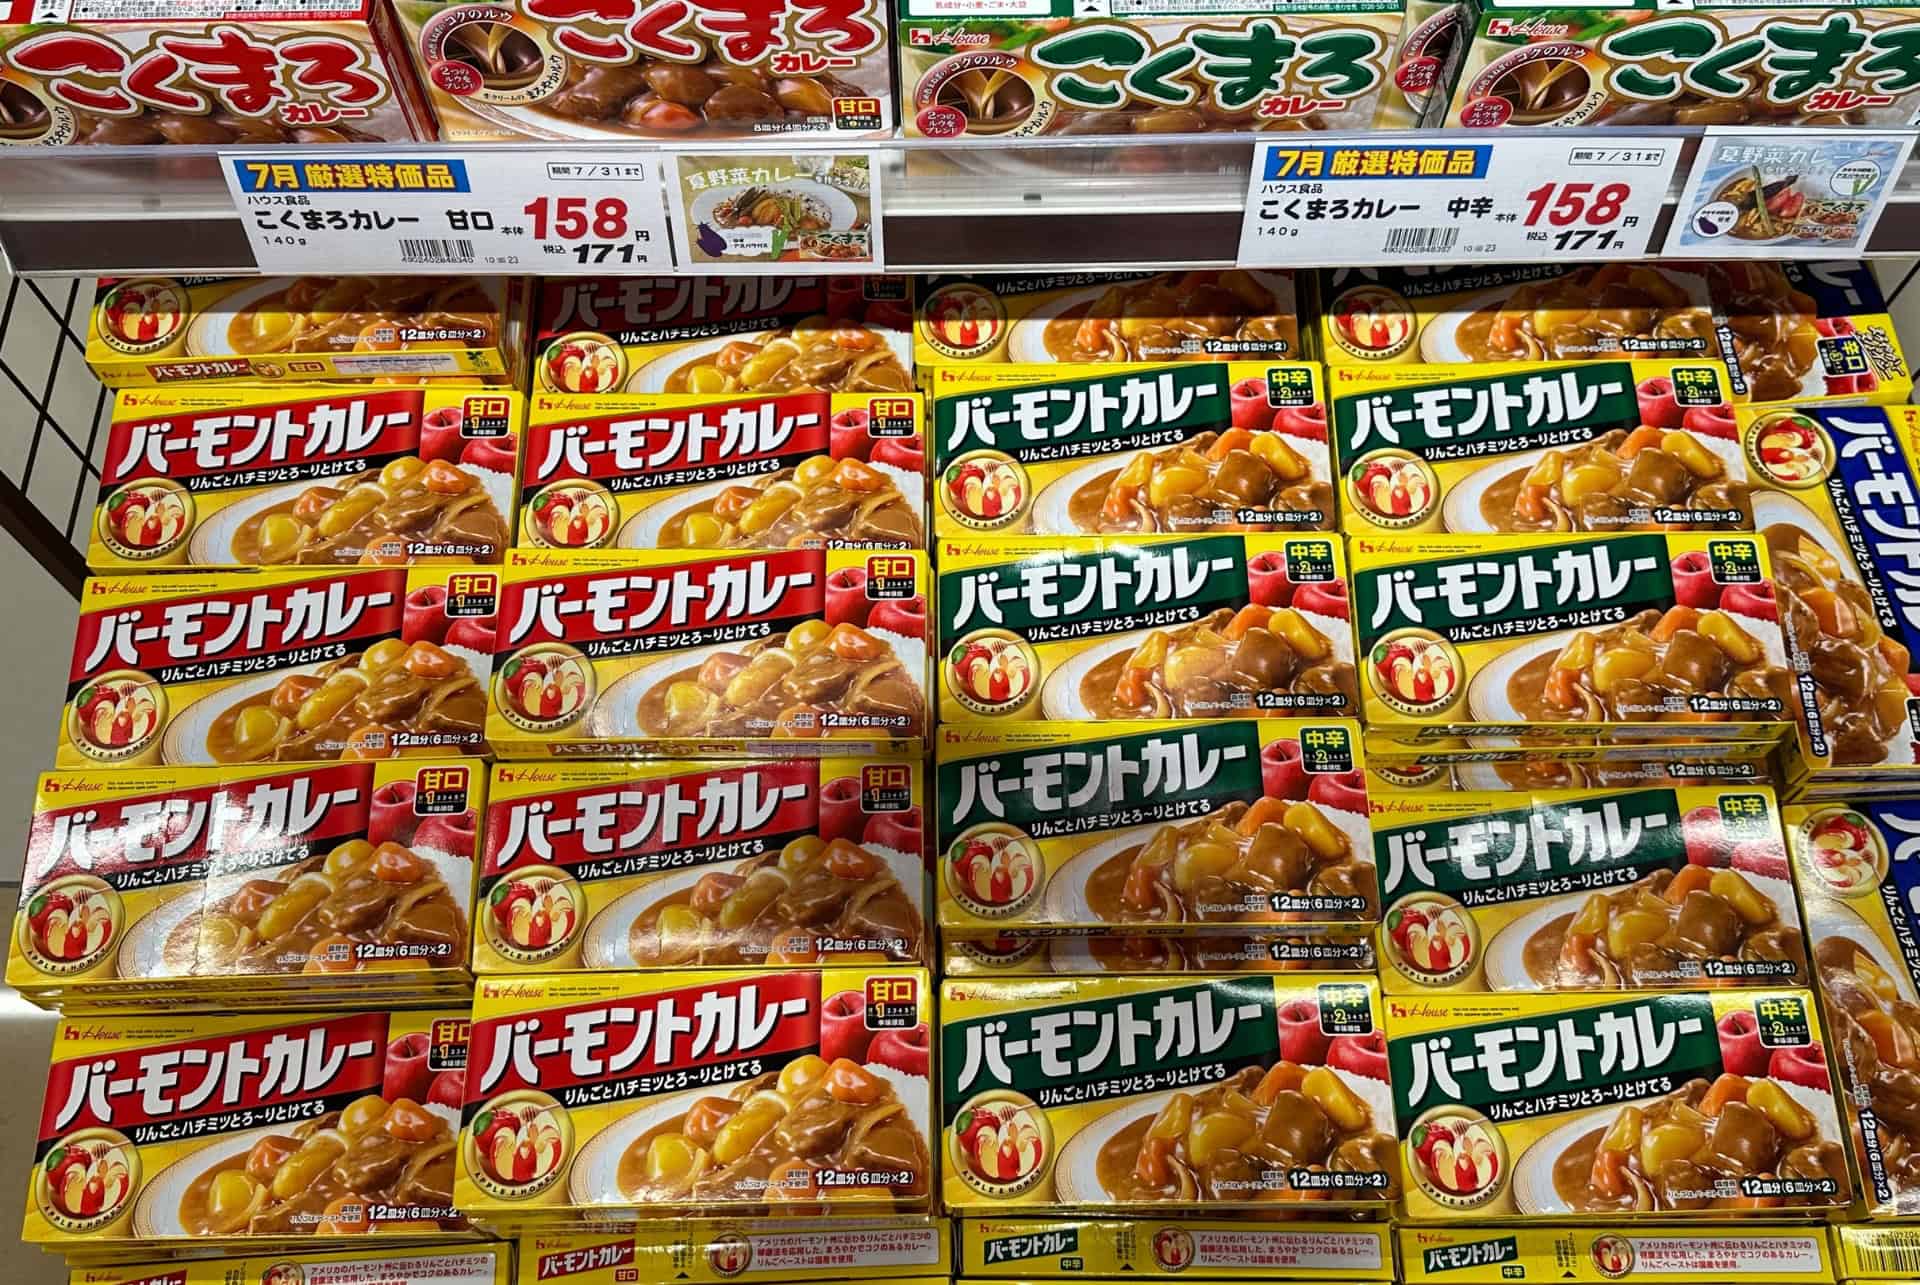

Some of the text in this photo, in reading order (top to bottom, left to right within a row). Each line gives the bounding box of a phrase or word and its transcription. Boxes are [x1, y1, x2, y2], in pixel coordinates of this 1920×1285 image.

[933, 28, 990, 45] House
[1511, 19, 1569, 36] House
[14, 28, 380, 113] こくまろ
[774, 54, 853, 71] カレー
[1038, 24, 1376, 105] こくまろ
[838, 100, 875, 113] 甘口
[1260, 98, 1344, 117] カレー
[1806, 91, 1892, 110] カレー
[281, 105, 365, 123] カレー
[1277, 150, 1475, 176] 7月 厳選特価品
[246, 163, 455, 189] 7月 厳選特価品
[686, 168, 813, 190] 夏野菜カレー
[1262, 184, 1323, 194] ハウス食品
[247, 195, 310, 205] ハウス食品
[1259, 197, 1493, 219] こくまろカレー 中辛
[1523, 182, 1631, 226] 158
[1623, 216, 1638, 227] 円
[255, 209, 494, 230] こくまろカレー 甘口
[524, 197, 628, 240] 158
[635, 231, 650, 241] 円
[264, 236, 307, 246] 140g
[1257, 227, 1298, 236] 140g
[1527, 232, 1547, 241] 税込
[1554, 230, 1617, 250] 171
[544, 244, 647, 263] 税込 171 円
[1271, 372, 1308, 386] 中辛
[1675, 371, 1708, 386] 中辛
[468, 399, 505, 416] 甘口
[873, 401, 909, 417] 甘口
[948, 374, 1218, 451] バーモントカレー
[1350, 373, 1623, 449] バーモントカレー
[117, 400, 409, 478] バーモントカレー
[538, 403, 821, 478] バーモントカレー
[1289, 544, 1328, 560] 中辛
[1713, 544, 1752, 560] 中辛
[872, 558, 910, 575] 甘口
[453, 578, 492, 594] 甘口
[953, 547, 1234, 630] バーモントカレー
[1371, 546, 1657, 628] バーモントカレー
[509, 560, 813, 644] バーモントカレー
[85, 582, 391, 672] バーモントカレー
[1305, 732, 1344, 749] 中辛
[423, 770, 463, 789] 甘口
[866, 767, 906, 787] 甘口
[953, 734, 1247, 825] バーモントカレー
[1723, 797, 1762, 815] 中辛
[38, 777, 359, 877] バーモントカレー
[496, 771, 807, 867] バーモントカレー
[1384, 802, 1668, 894] バーモントカレー
[871, 980, 913, 1000] 甘口
[1323, 989, 1364, 1008] 中辛
[1759, 1002, 1800, 1020] 中辛
[481, 985, 807, 1093] バーモントカレー
[958, 991, 1264, 1093] バーモントカレー
[1408, 1005, 1704, 1106] バーモントカレー
[56, 1027, 375, 1131] バーモントカレー
[988, 1234, 1074, 1261] バーモントカレー
[1429, 1242, 1513, 1270] バーモントカレー
[542, 1246, 631, 1277] バーモントカレー
